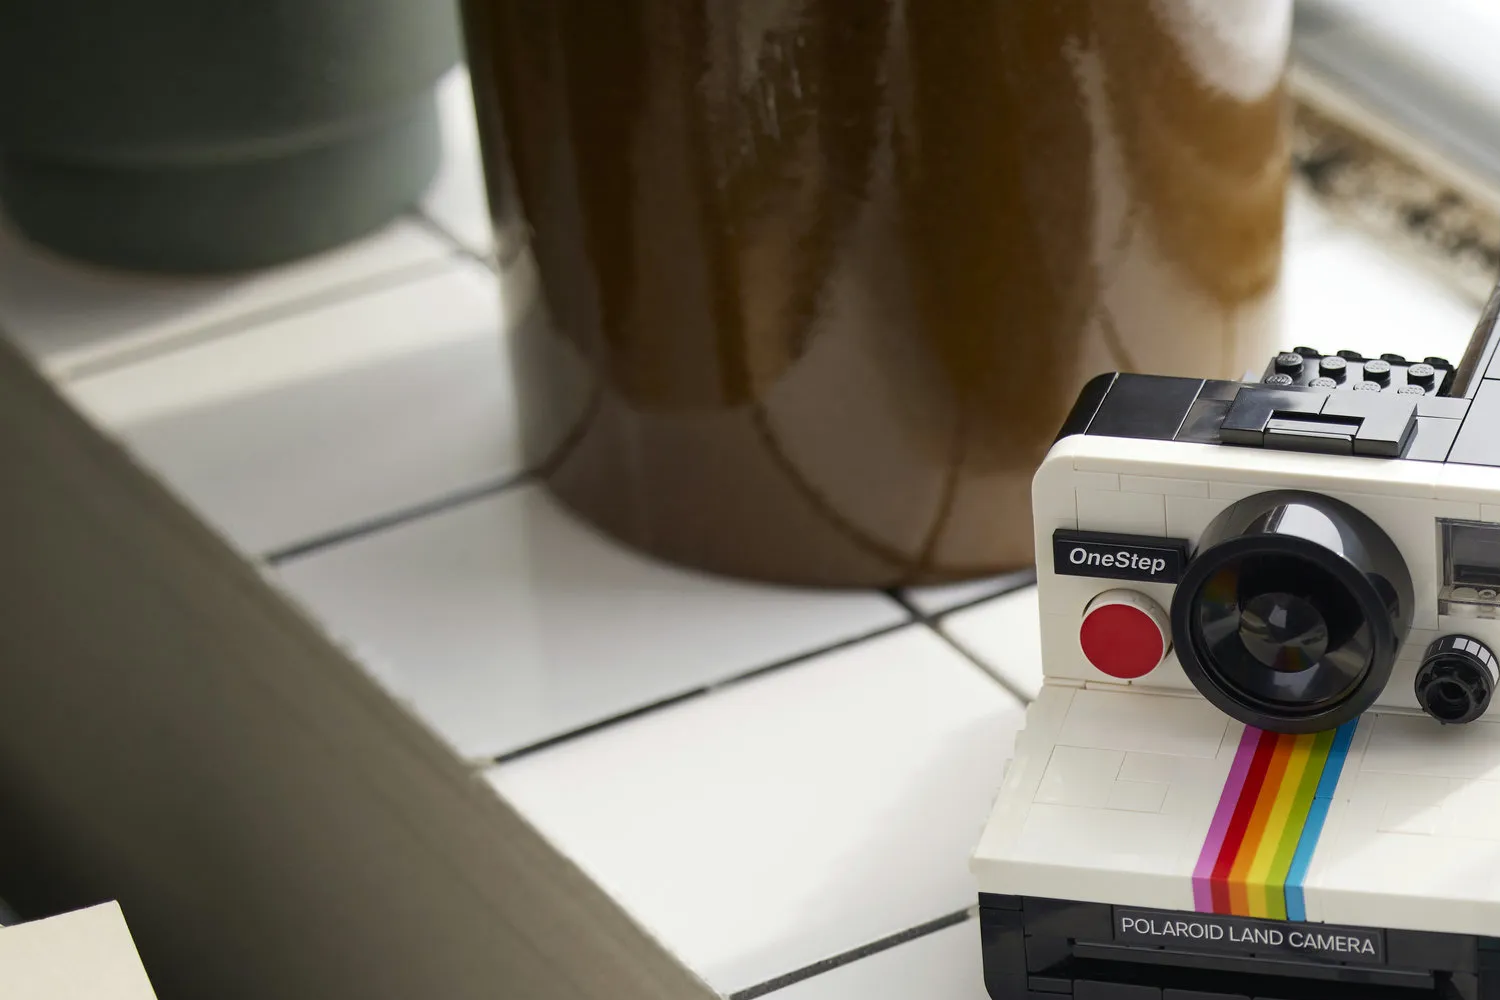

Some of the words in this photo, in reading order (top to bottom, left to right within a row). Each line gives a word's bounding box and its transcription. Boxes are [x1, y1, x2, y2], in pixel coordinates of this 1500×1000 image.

[1069, 547, 1166, 575] OneStep
[1121, 917, 1224, 940] POLAROID
[1229, 926, 1284, 946] LAND
[1288, 931, 1376, 955] CAMERA
